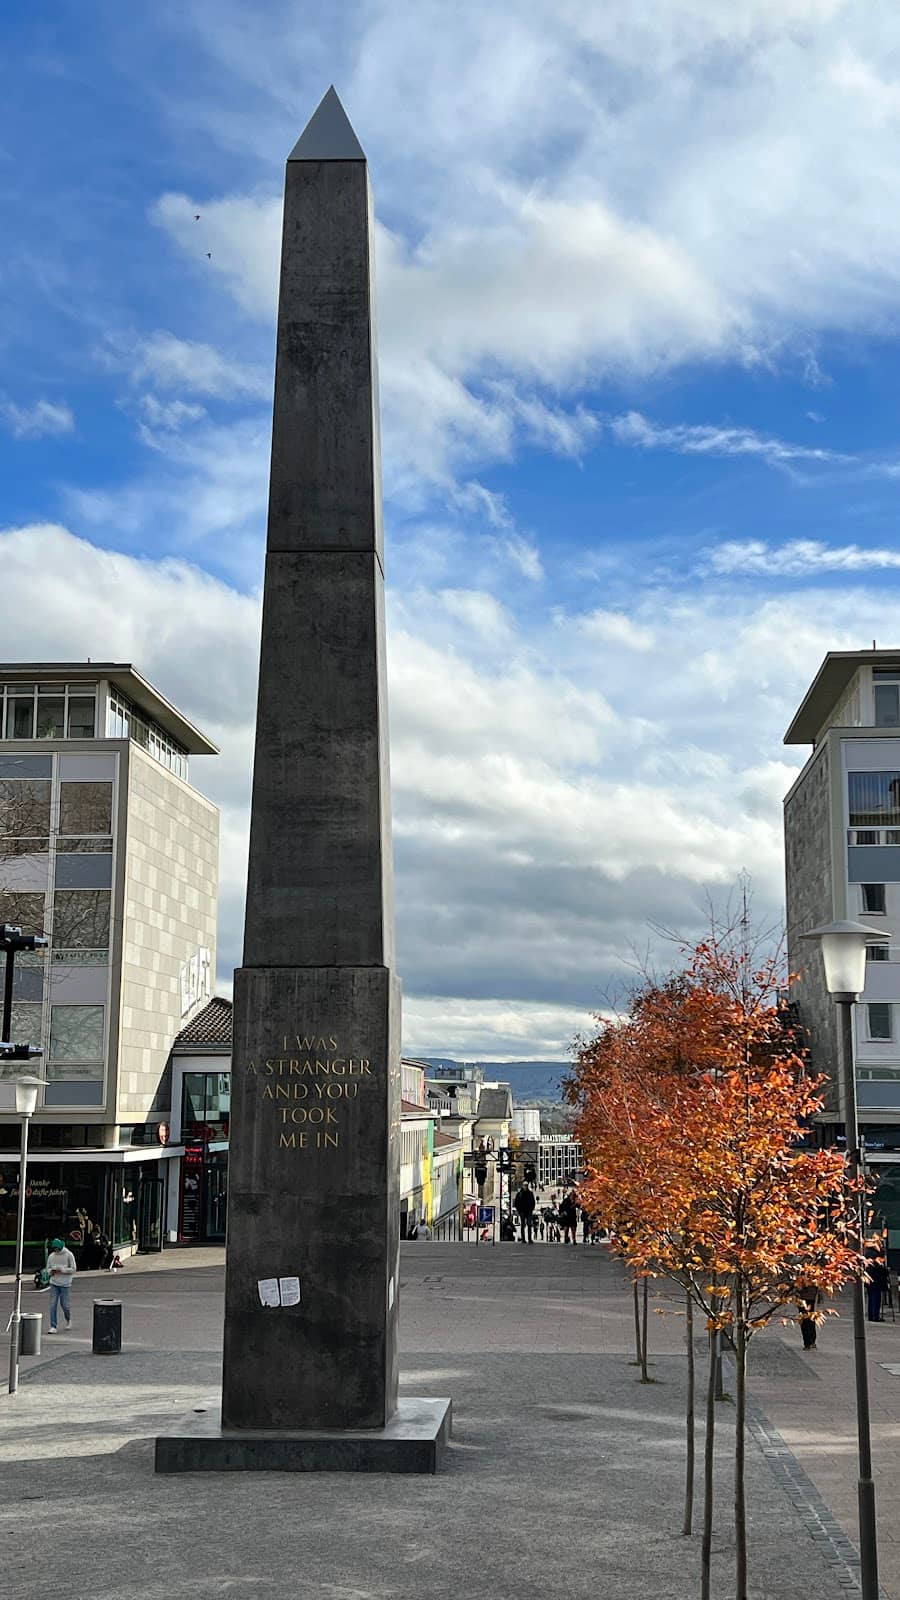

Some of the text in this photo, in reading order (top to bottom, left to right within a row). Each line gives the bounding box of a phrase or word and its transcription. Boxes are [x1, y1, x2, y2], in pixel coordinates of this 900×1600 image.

[283, 1034, 338, 1051] I WAS
[246, 1059, 373, 1076] A STRANGER
[262, 1083, 359, 1099] AND YOU
[279, 1107, 339, 1124] TOOK
[279, 1132, 339, 1148] ME IN
[542, 1134, 576, 1143] STAATSTHEAT
